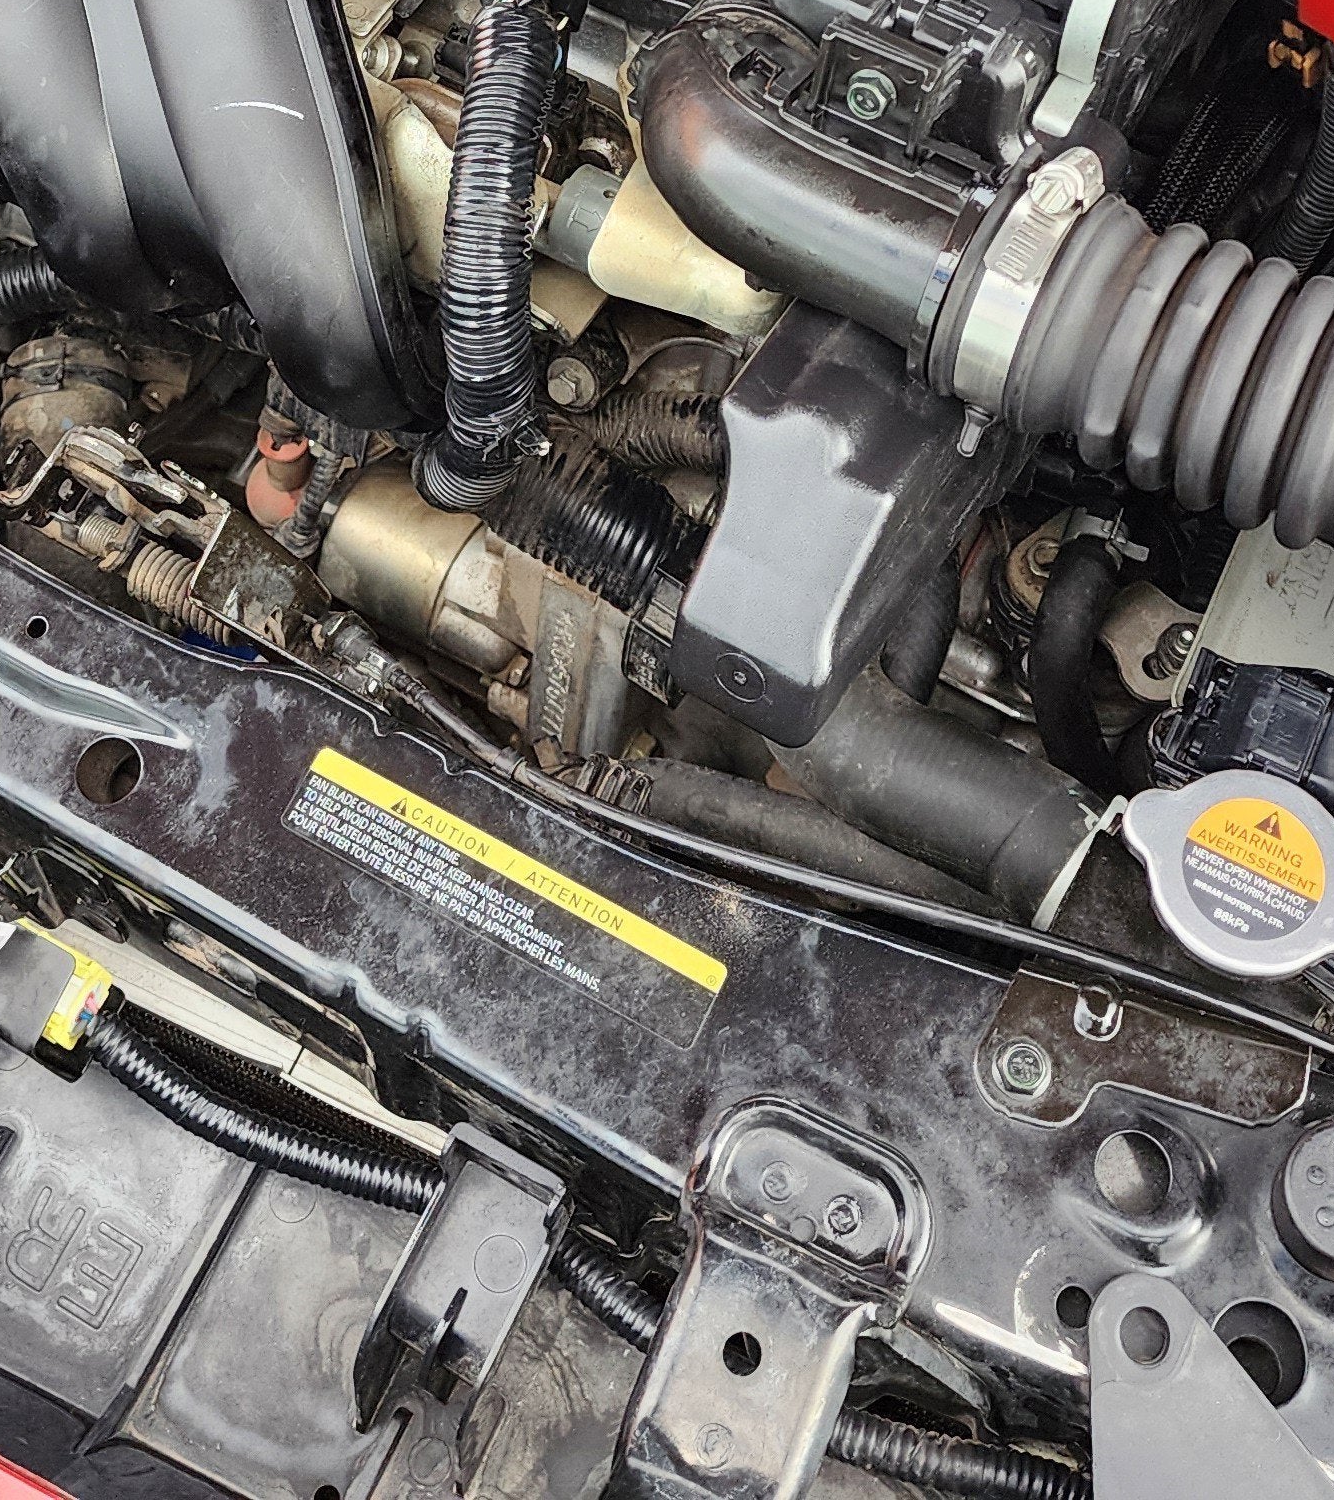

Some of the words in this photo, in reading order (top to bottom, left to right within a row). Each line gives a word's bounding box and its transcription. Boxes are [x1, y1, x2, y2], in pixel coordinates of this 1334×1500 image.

[307, 773, 330, 793] FAN
[326, 783, 360, 809] BLADE
[354, 799, 379, 820] CAN
[374, 810, 406, 835] START
[402, 826, 419, 842] AT
[414, 832, 438, 852] ANY
[433, 842, 463, 866] TIME.
[1224, 820, 1303, 868] WARNING
[293, 796, 311, 814] LE
[306, 803, 373, 848] VENTILATEUR
[369, 838, 410, 869] RISQUE
[406, 858, 425, 877] DE
[420, 865, 481, 908] DÉMARRER
[473, 894, 489, 912] À
[483, 901, 517, 927] TOUT
[512, 917, 566, 955] MOMENT.
[301, 785, 319, 802] TO
[315, 793, 342, 815] HELP
[337, 805, 371, 831] AVOID
[366, 821, 416, 856] PERSONAL
[411, 846, 449, 876] INJURY,
[445, 864, 471, 886] KEEP
[467, 876, 505, 905] HANDS
[501, 895, 538, 923] CLEAR.
[409, 804, 491, 859] CAUTION
[523, 867, 624, 933] ATTENTION
[1184, 854, 1199, 869] NE
[1195, 860, 1230, 884] JAMAIS
[1227, 876, 1266, 902] OUVRIR
[1191, 845, 1228, 869] NEVER
[1225, 861, 1254, 883] OPEN
[1253, 874, 1285, 898] WHEN
[1196, 828, 1316, 893] AVERTISSEMENT
[287, 808, 321, 835] POUR
[316, 823, 354, 852] ÉVITER
[348, 842, 384, 870] TOUTE
[431, 888, 450, 907] NE
[446, 897, 470, 918] PAS
[466, 908, 485, 926] EN
[482, 916, 547, 960] APPROCHER
[543, 950, 567, 971] LES
[563, 961, 605, 992] MAINS.
[1192, 877, 1223, 898] NISSAN
[1221, 893, 1252, 913] MOTOR
[1212, 906, 1250, 933] 88kPa
